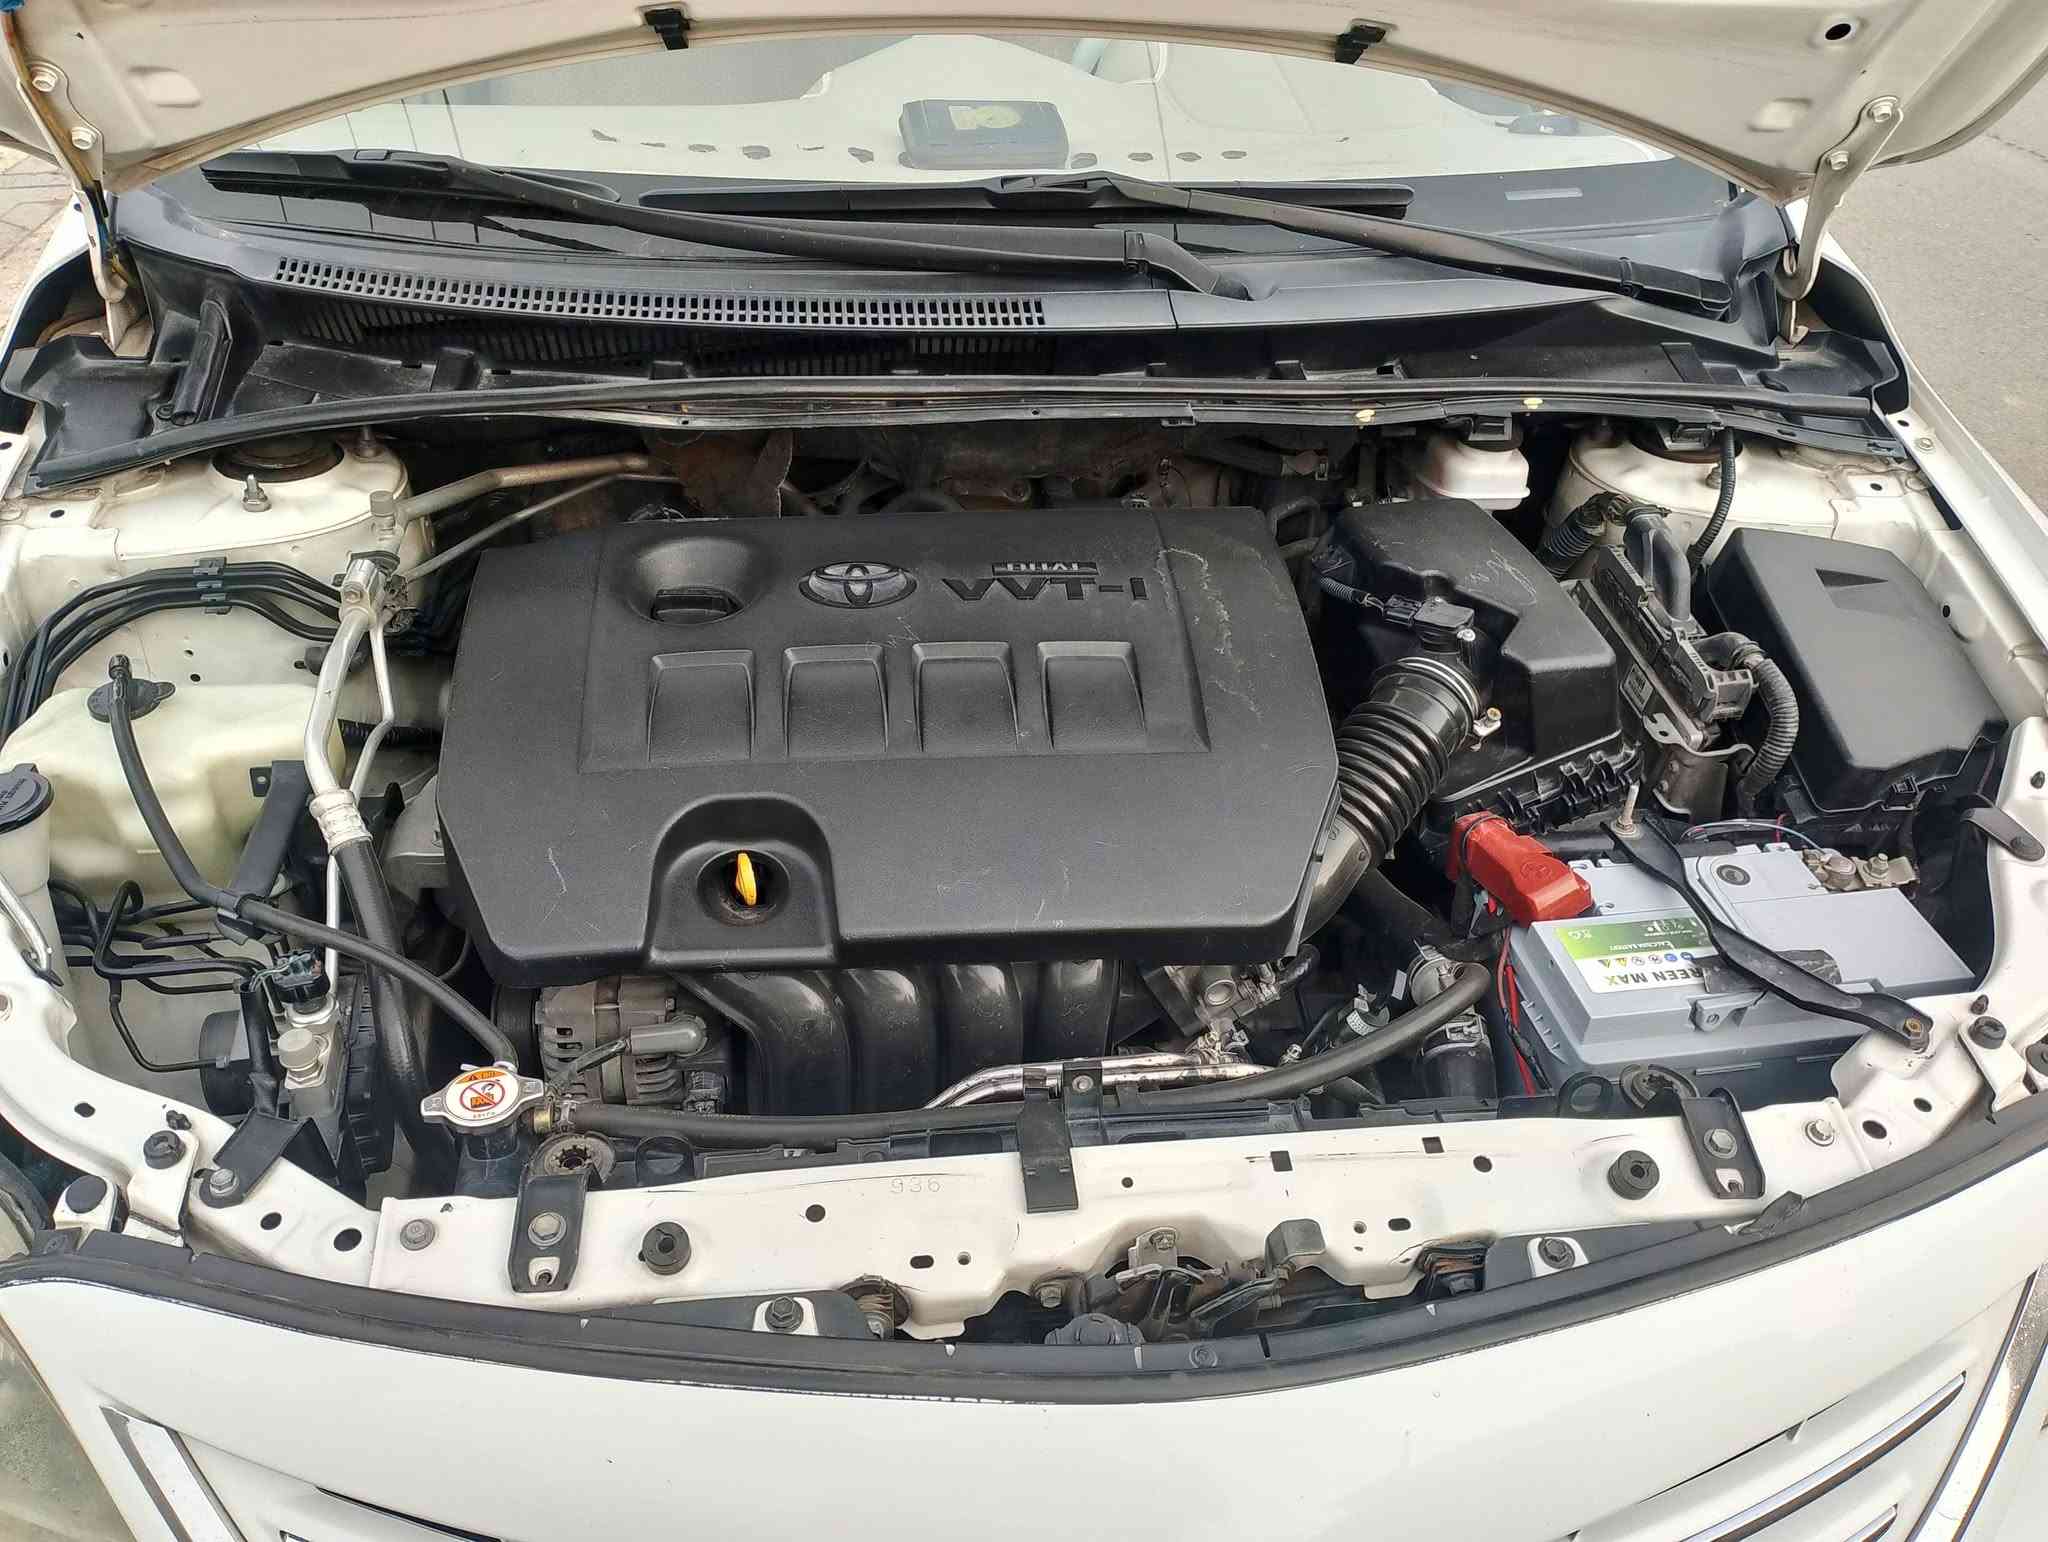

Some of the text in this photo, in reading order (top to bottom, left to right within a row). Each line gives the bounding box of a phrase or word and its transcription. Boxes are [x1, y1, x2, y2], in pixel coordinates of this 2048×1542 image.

[1606, 967, 1704, 986] REEN MAX
[890, 1176, 941, 1194] 936
